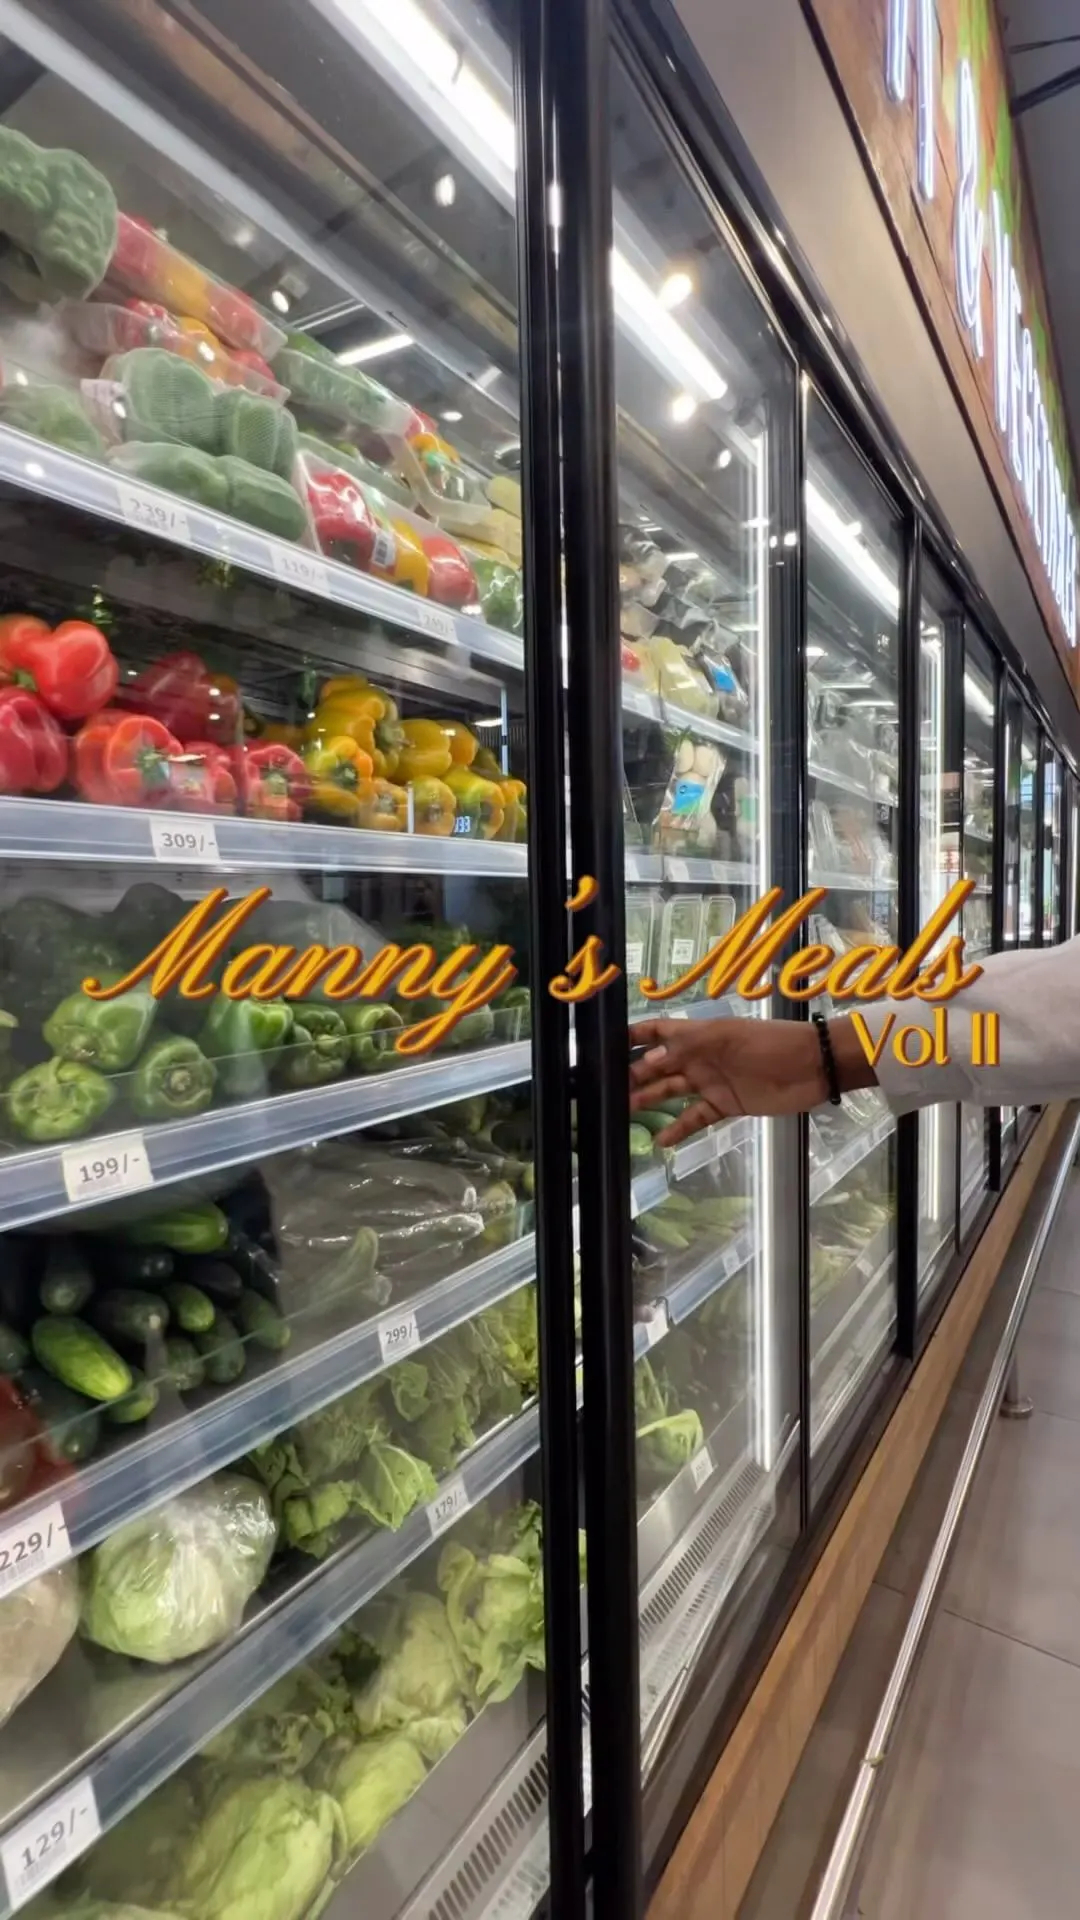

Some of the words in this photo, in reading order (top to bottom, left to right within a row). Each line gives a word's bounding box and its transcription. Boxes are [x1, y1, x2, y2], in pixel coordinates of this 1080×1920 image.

[161, 832, 216, 852] 309/-
[79, 1153, 141, 1183] 199/-
[385, 1321, 419, 1345] 299/-
[434, 1489, 463, 1521] 179/-
[0, 1521, 68, 1573] 229/-
[21, 1806, 89, 1871] 129/-
